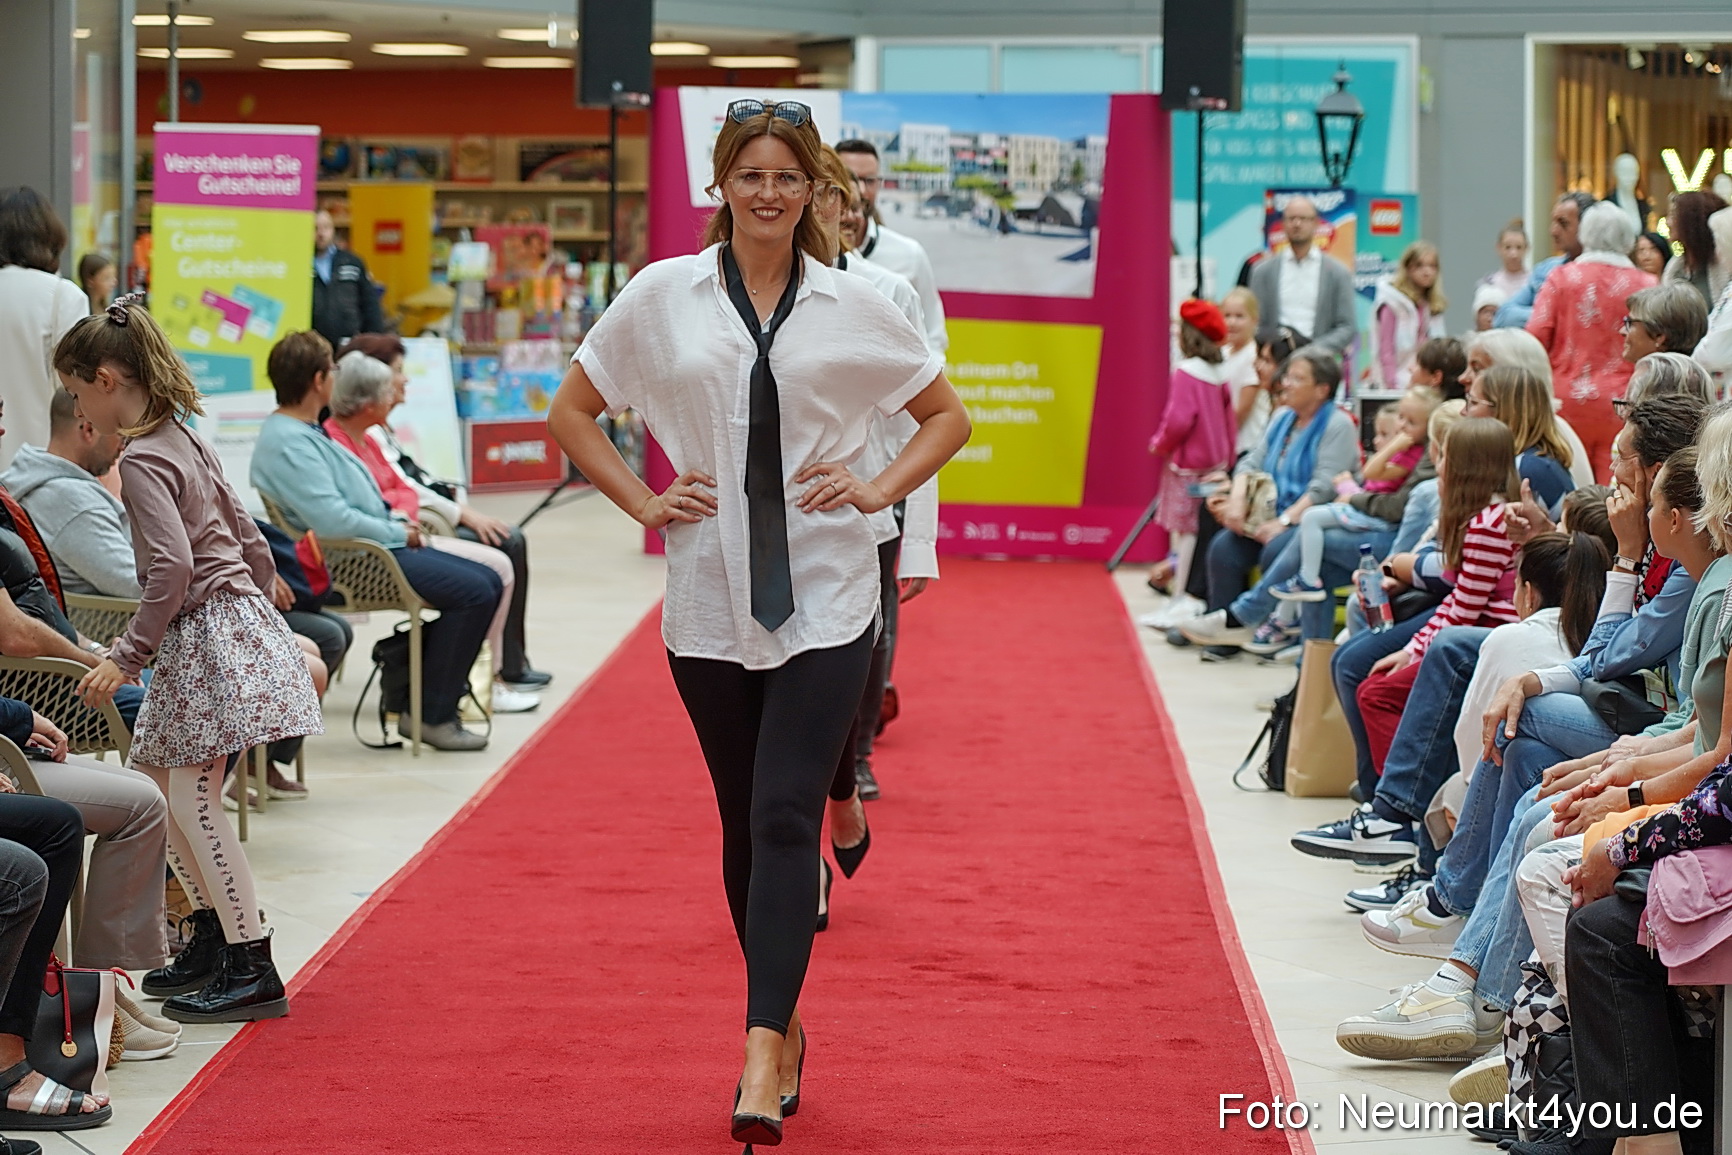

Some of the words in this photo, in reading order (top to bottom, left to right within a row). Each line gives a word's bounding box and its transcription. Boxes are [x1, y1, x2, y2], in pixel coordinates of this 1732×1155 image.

[163, 152, 273, 175] Verschenken
[273, 153, 302, 176] Sie
[1660, 147, 1732, 192] V
[197, 174, 302, 196] Gutscheine!
[177, 255, 289, 279] Gutscheine
